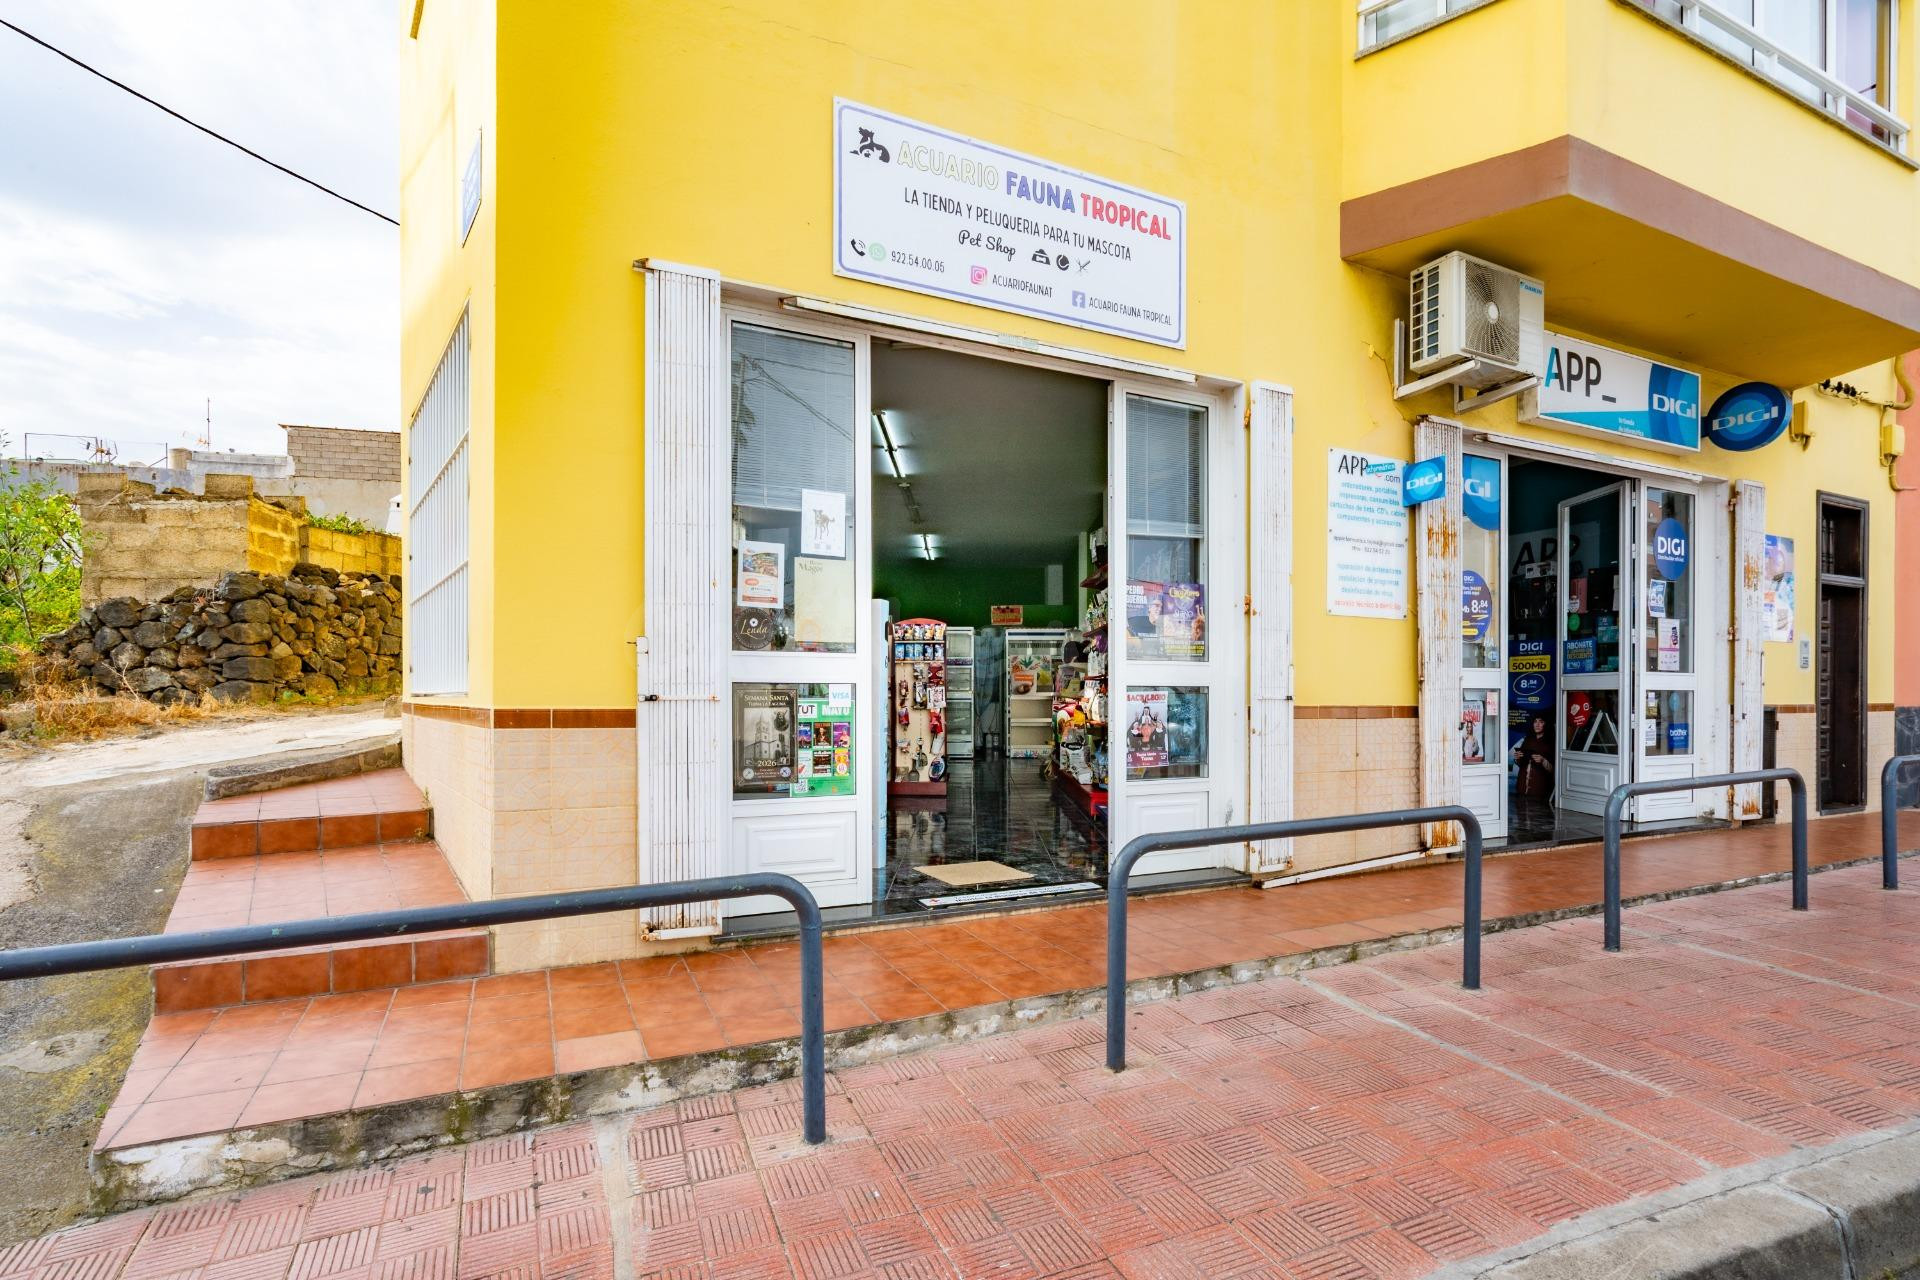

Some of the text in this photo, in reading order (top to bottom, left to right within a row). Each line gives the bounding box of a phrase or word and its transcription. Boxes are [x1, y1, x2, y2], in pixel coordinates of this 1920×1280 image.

[897, 140, 1172, 241] ACUARIO FAUNA TROPICAL
[904, 187, 1131, 261] LA TIENDA Y PELUQUERIA PARA TU MASCOTA
[958, 229, 1016, 262] Pet Shop
[891, 250, 945, 273] 922.54.00.05
[992, 274, 1053, 298] ACUARIOFAUNAT
[1088, 297, 1172, 325] ACUARIO FAUNA TROPICAL
[1652, 393, 1696, 419] DIGI
[1712, 405, 1778, 431] DIGI
[1338, 454, 1369, 476] APP
[1406, 472, 1443, 490] DIGI
[1657, 536, 1685, 556] DIGI
[1519, 642, 1543, 652] DIGI
[1512, 661, 1547, 671] 500Mb
[1670, 728, 1688, 737] brother
